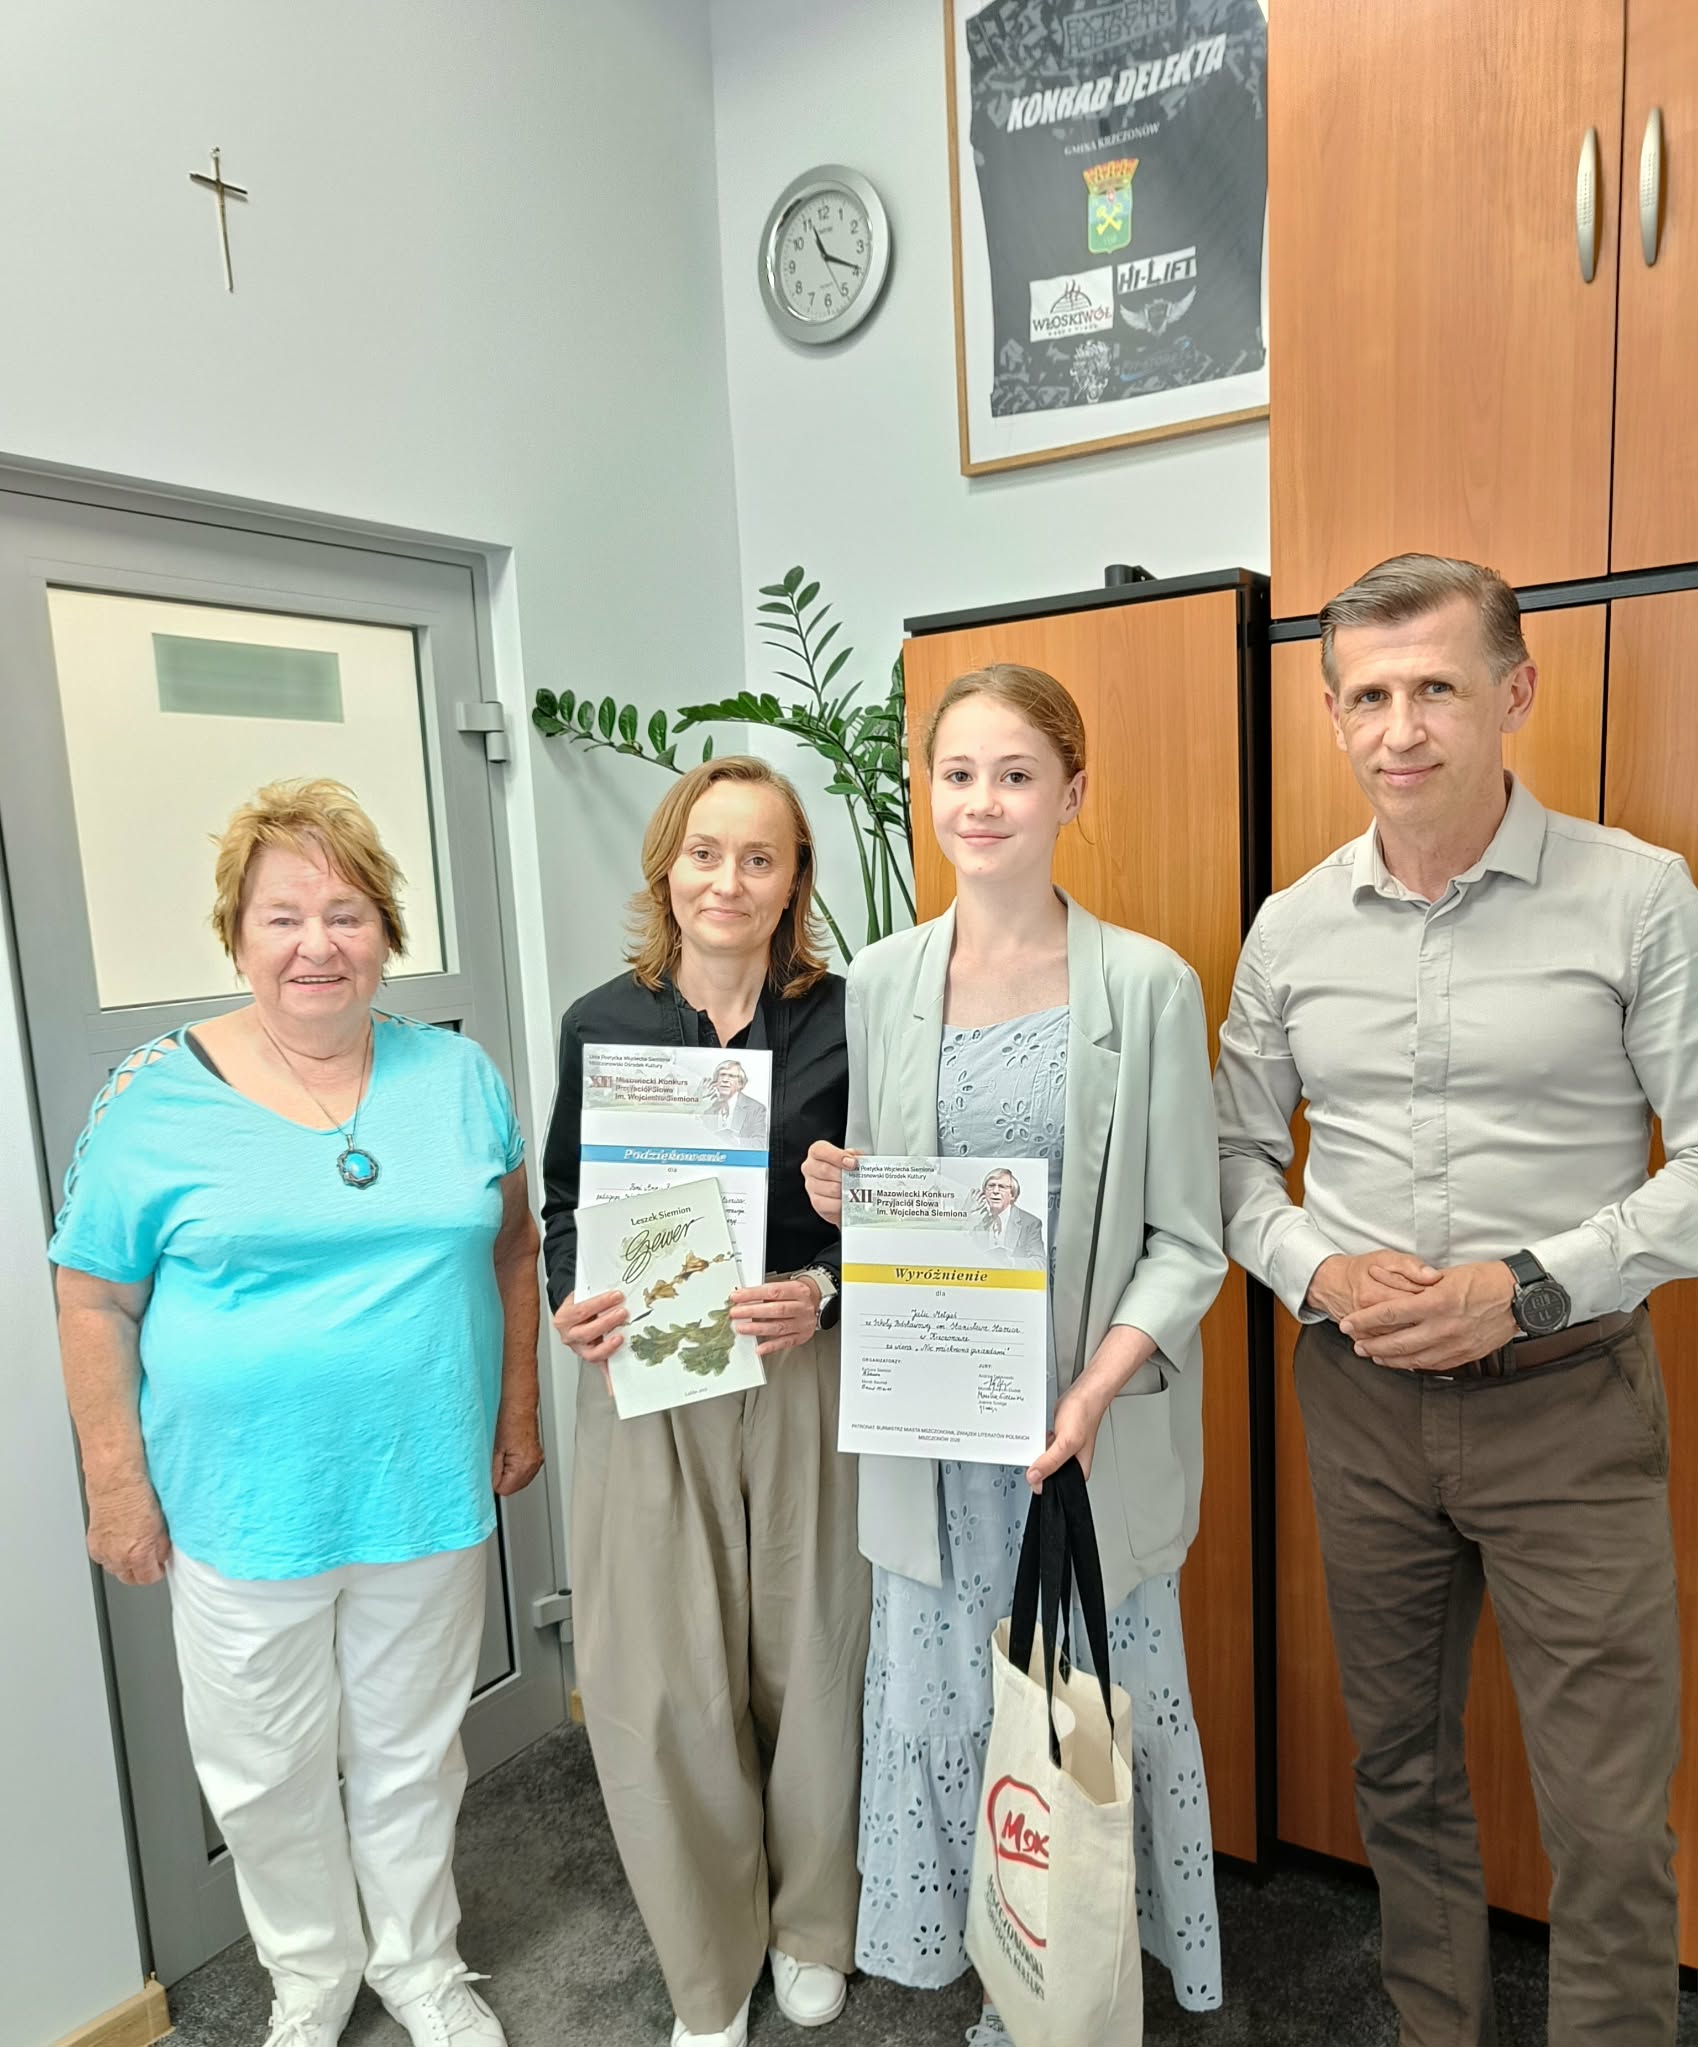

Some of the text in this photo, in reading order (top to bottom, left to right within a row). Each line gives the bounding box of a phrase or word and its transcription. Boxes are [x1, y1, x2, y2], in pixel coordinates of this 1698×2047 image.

[1006, 32, 1227, 133] KONRAD DELEKTA
[1064, 140, 1097, 156] GMINA
[818, 205, 830, 220] 12
[839, 208, 844, 221] 1
[803, 219, 813, 232] 11
[851, 220, 859, 235] 2
[794, 237, 804, 251] 10
[856, 240, 864, 254] 3
[789, 260, 796, 274] 9
[1119, 256, 1197, 293] HI-LIFT
[796, 281, 803, 295] 8
[841, 282, 849, 297] 5
[808, 292, 815, 306] 7
[824, 293, 832, 308] 6
[624, 1149, 728, 1164] Podziękowanie
[849, 1189, 873, 1203] XII
[877, 1190, 955, 1199] Mazowiecki Konkurs
[877, 1199, 939, 1208] Przyjaciół Słowa
[631, 1207, 691, 1226] Leszek Siemion
[890, 1208, 929, 1217] Wojciecha
[931, 1210, 968, 1218] Siemiona
[895, 1267, 988, 1282] Wyróżnienie
